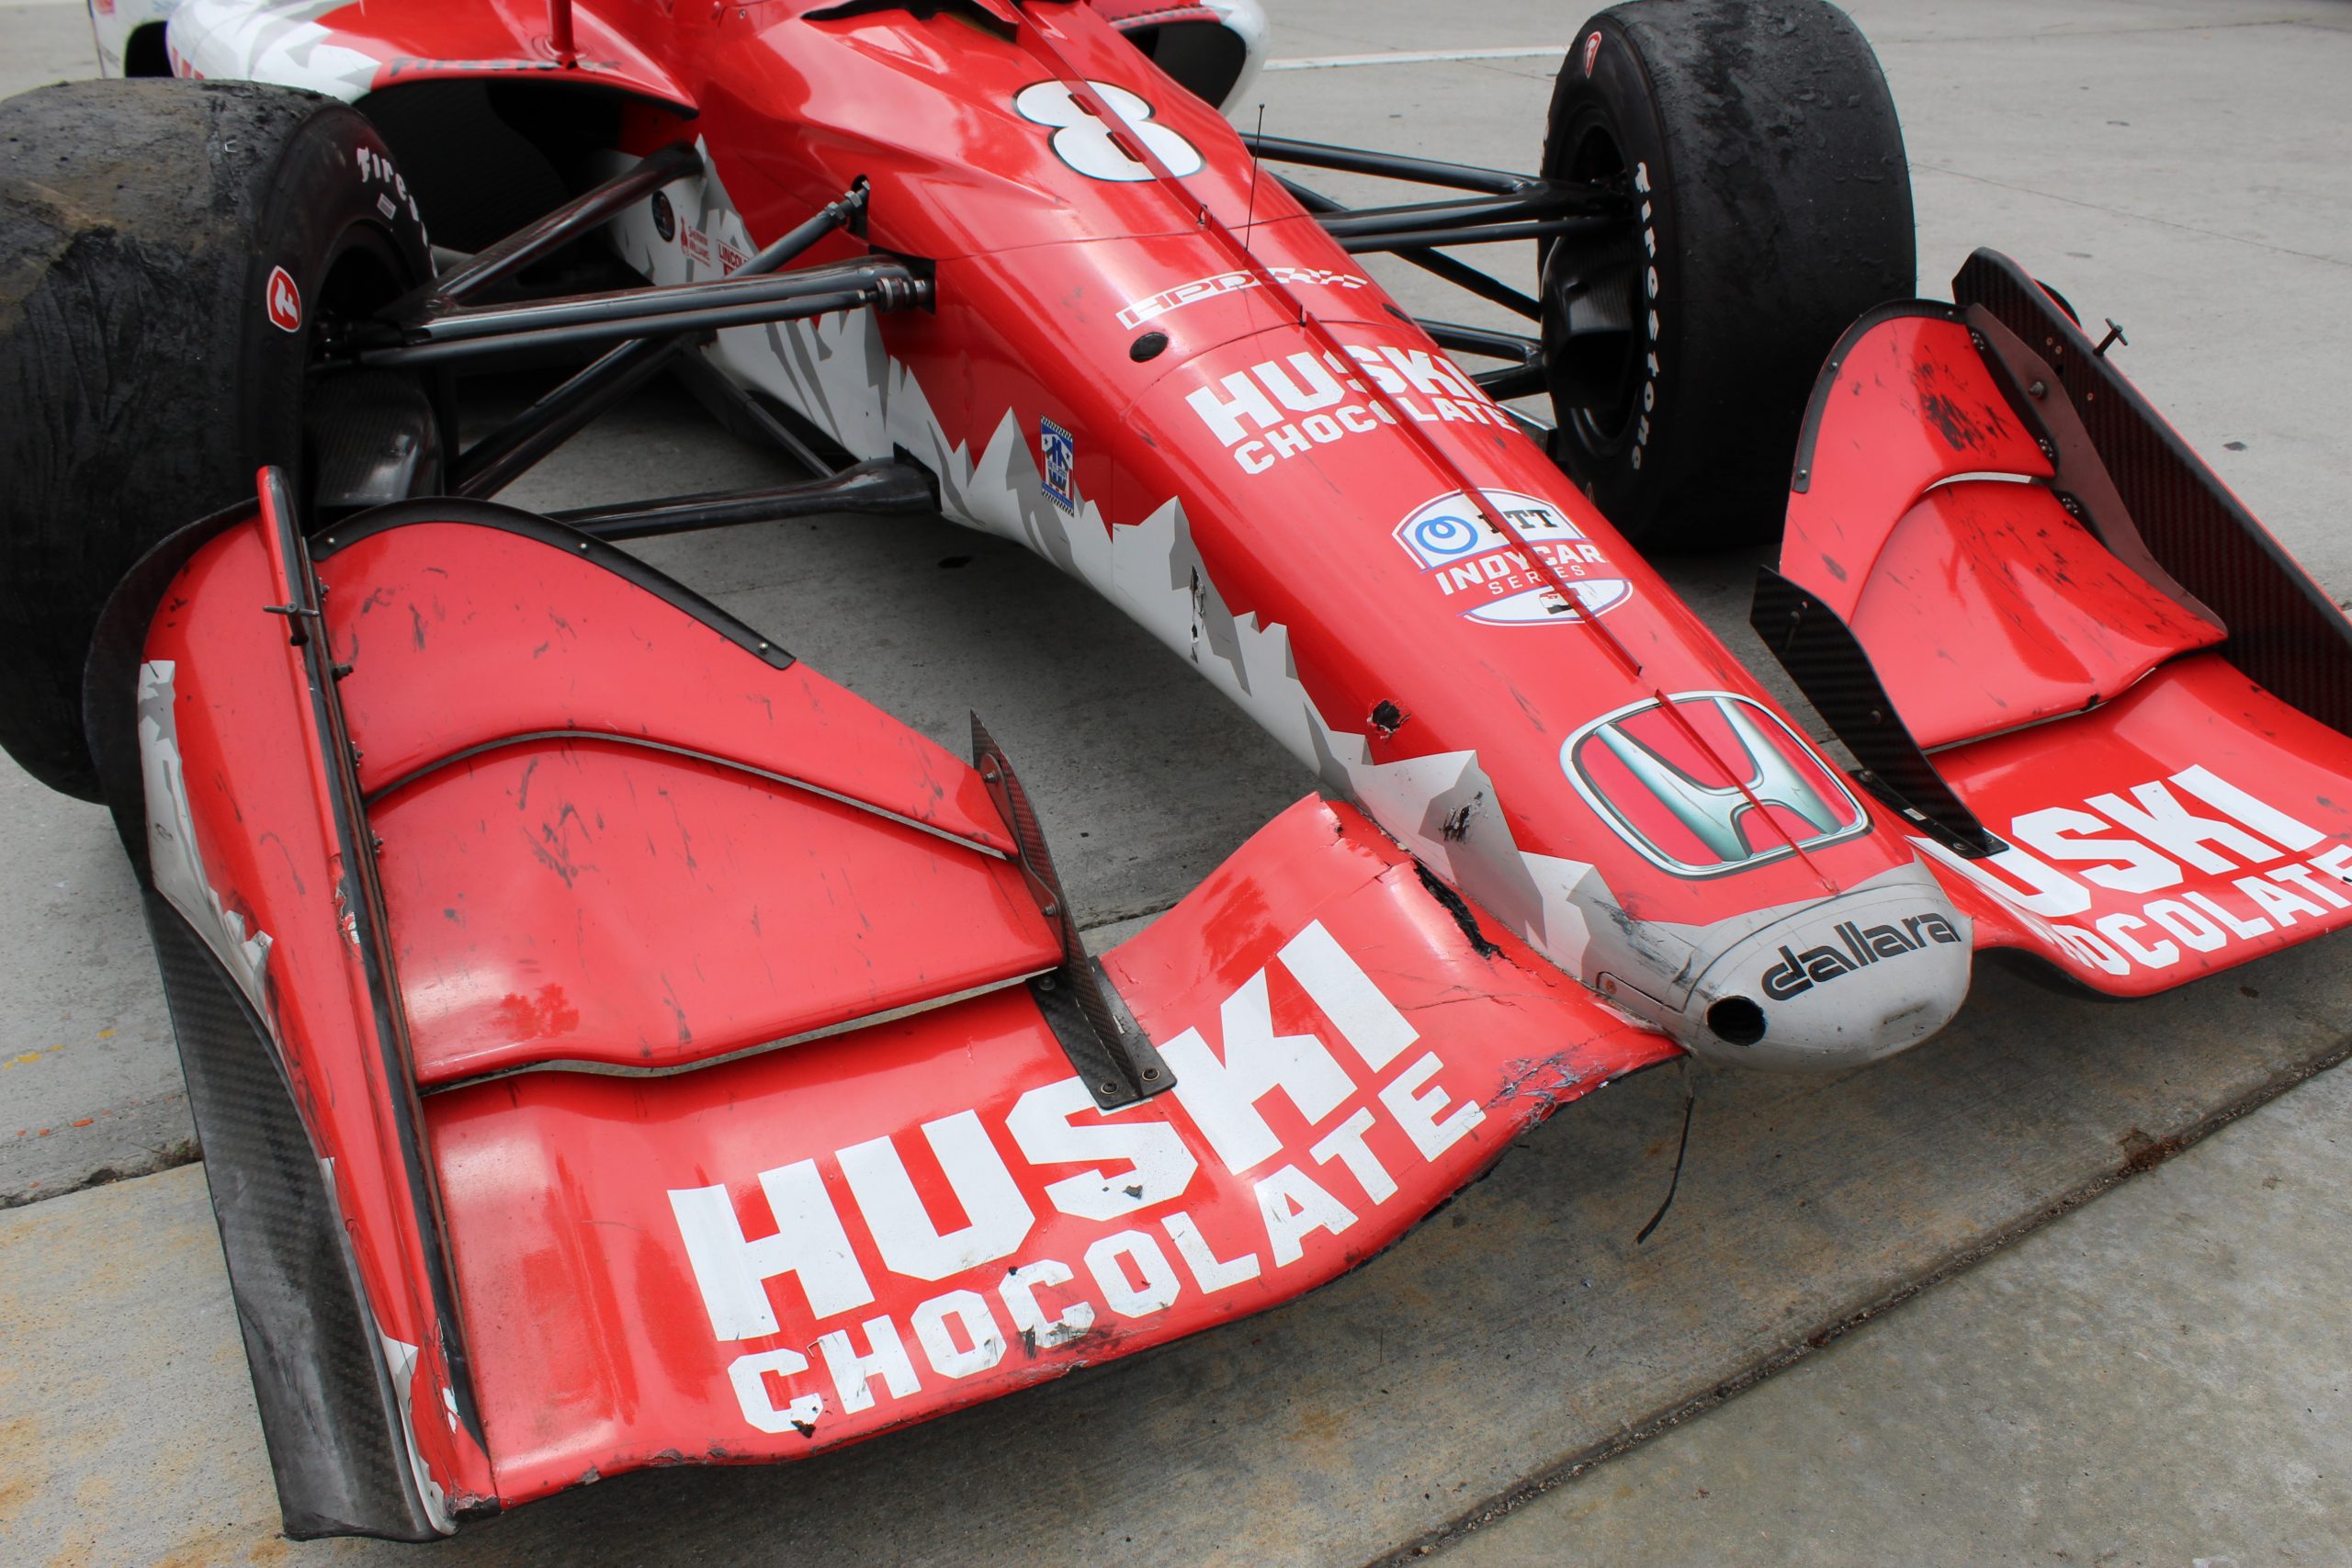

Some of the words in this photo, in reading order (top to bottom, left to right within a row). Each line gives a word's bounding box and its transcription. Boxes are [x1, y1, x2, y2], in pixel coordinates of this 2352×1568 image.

[1013, 77, 1207, 183] 8
[1184, 344, 1495, 448] HUSKI
[1435, 543, 1608, 596] INDYCAR
[1487, 565, 1586, 595] SERES
[1903, 763, 2328, 917] USKI
[1761, 912, 1962, 1001] dallara
[667, 919, 1420, 1342] HUSKI
[727, 1052, 1487, 1435] CHOCOLATE
